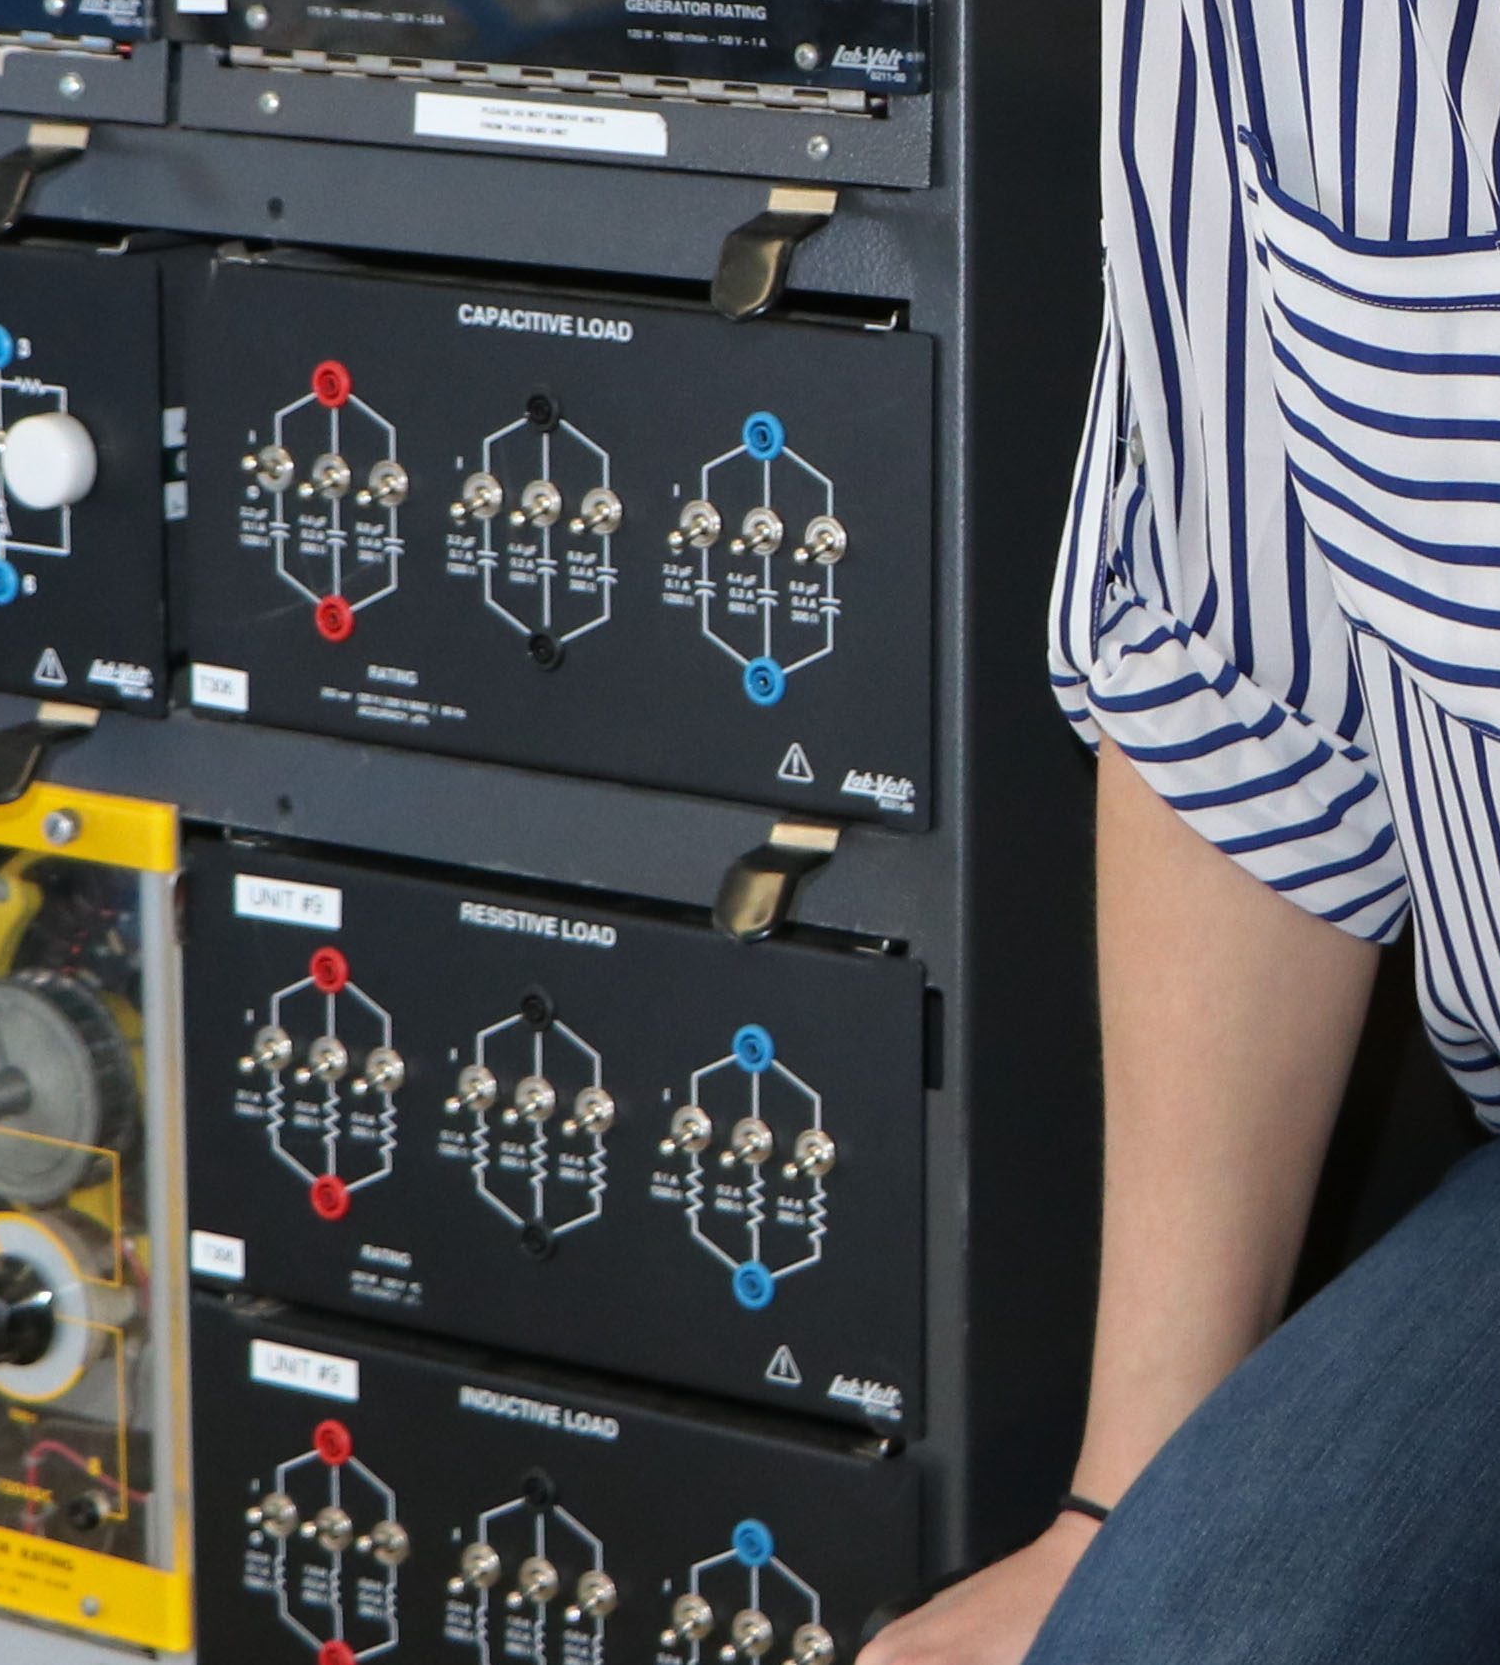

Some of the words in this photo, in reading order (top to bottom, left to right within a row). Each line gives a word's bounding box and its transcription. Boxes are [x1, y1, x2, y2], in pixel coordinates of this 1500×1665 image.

[713, 0, 768, 21] RATING
[832, 44, 900, 73] Lab-Volt
[458, 303, 575, 338] CAPACITIVE
[577, 316, 634, 343] LOAD
[841, 770, 915, 799] Lab-Volt
[249, 886, 295, 912] UNIT
[460, 901, 558, 937] RESISTIVE
[560, 920, 618, 949] LOAD
[267, 1352, 312, 1378] UNIT
[460, 1385, 561, 1429] INDUCTIVE
[563, 1410, 620, 1440] LOAD
